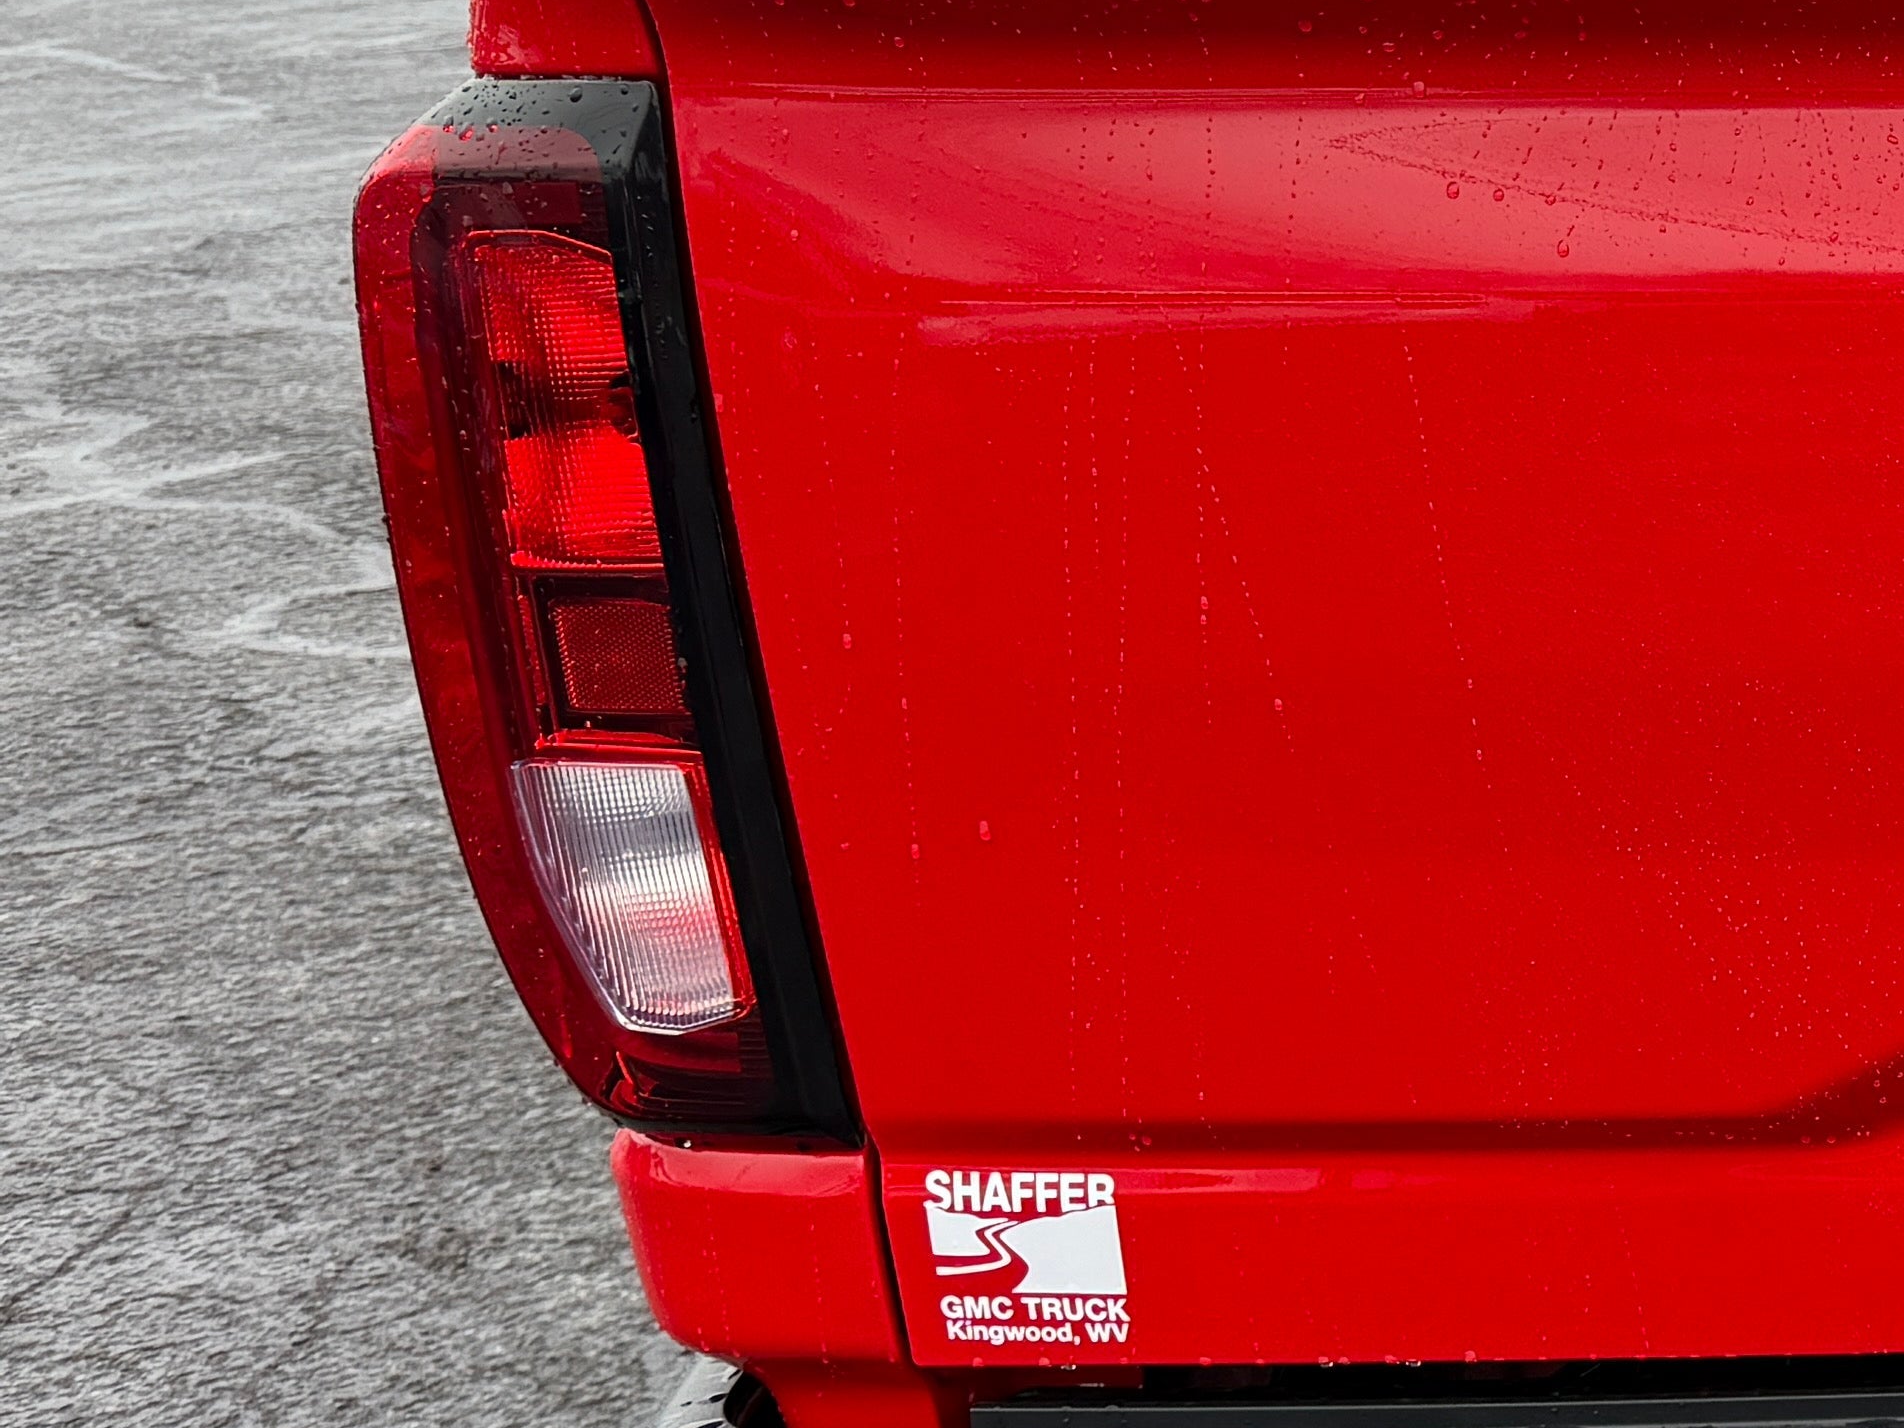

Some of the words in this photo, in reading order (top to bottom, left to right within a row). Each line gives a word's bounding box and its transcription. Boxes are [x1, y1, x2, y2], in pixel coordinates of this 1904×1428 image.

[923, 1170, 1115, 1212] SHAFFER
[940, 1295, 1014, 1320] GMC
[1020, 1296, 1131, 1322] TRUCK
[946, 1320, 1081, 1346] Kingwood,
[1084, 1322, 1129, 1343] WV
